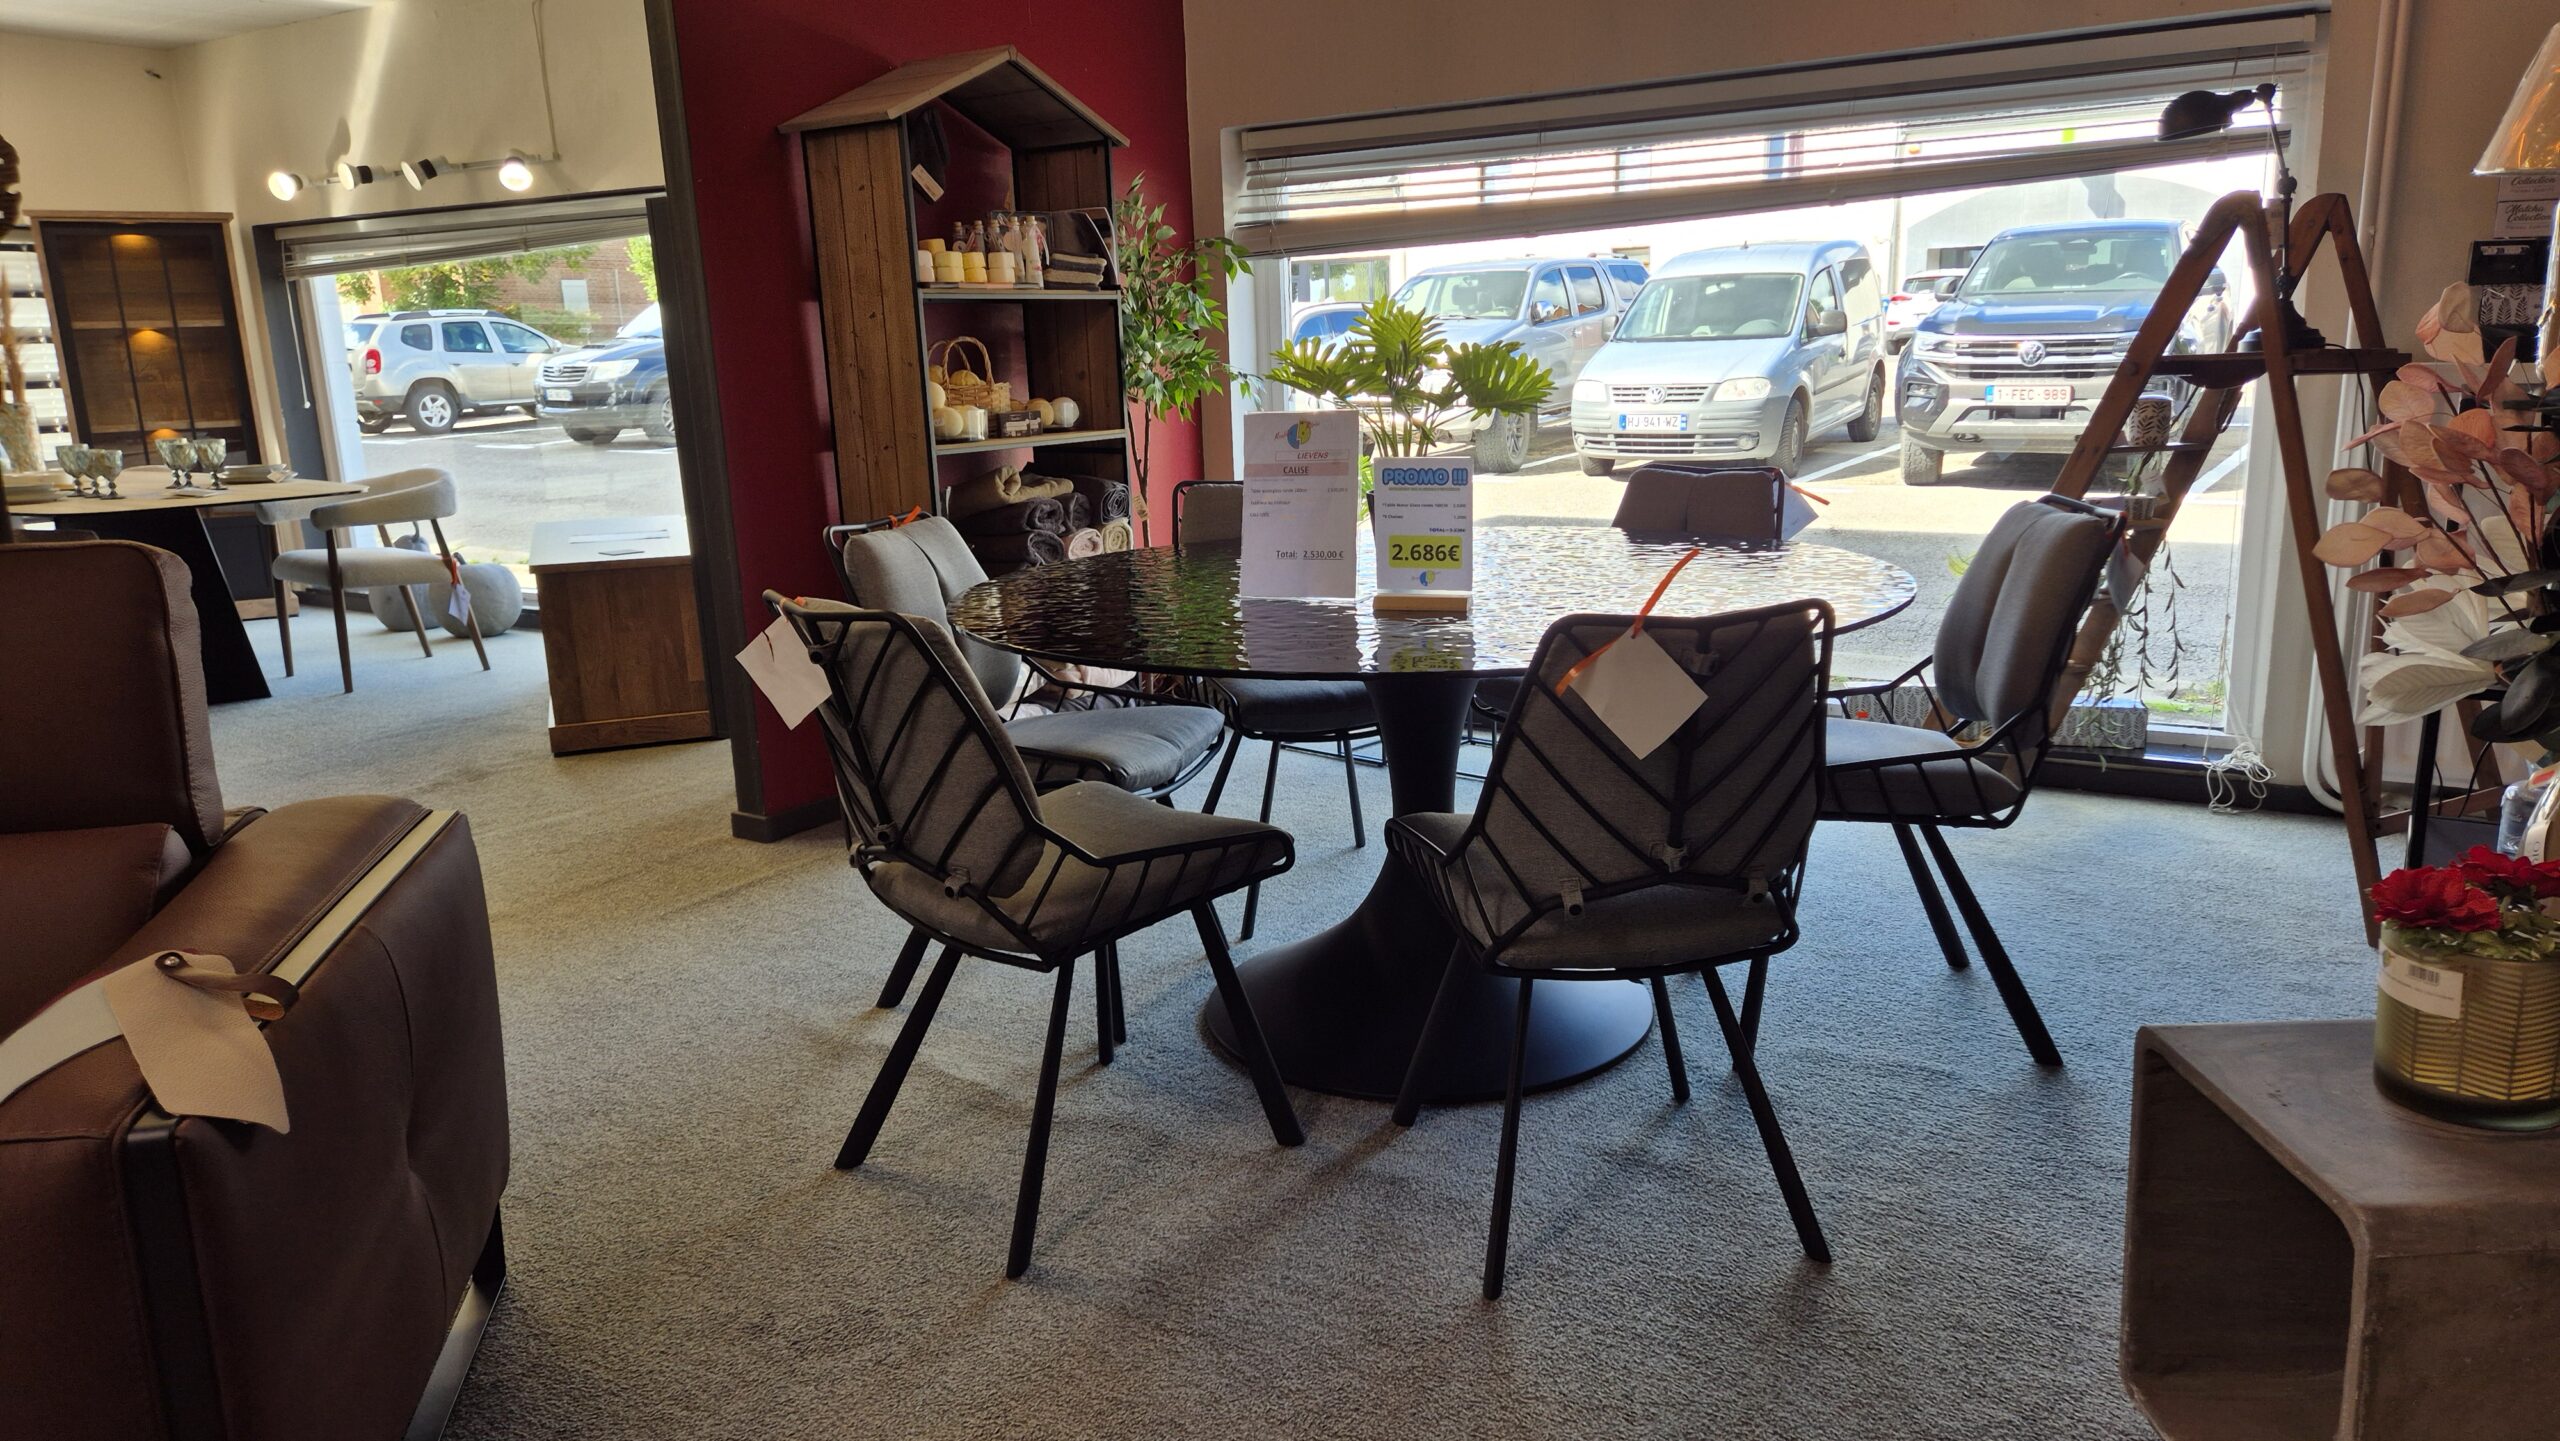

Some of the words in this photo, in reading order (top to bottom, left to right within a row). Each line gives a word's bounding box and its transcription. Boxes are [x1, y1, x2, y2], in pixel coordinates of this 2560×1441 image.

[1998, 389, 2067, 400] 1-FEC-989
[1297, 452, 1328, 460] LIEVENS
[1283, 466, 1310, 475] CALISE
[1382, 468, 1449, 485] PROMO
[1451, 468, 1468, 486] !!!
[1276, 550, 1298, 559] Total:
[1391, 544, 1461, 562] 2.686€
